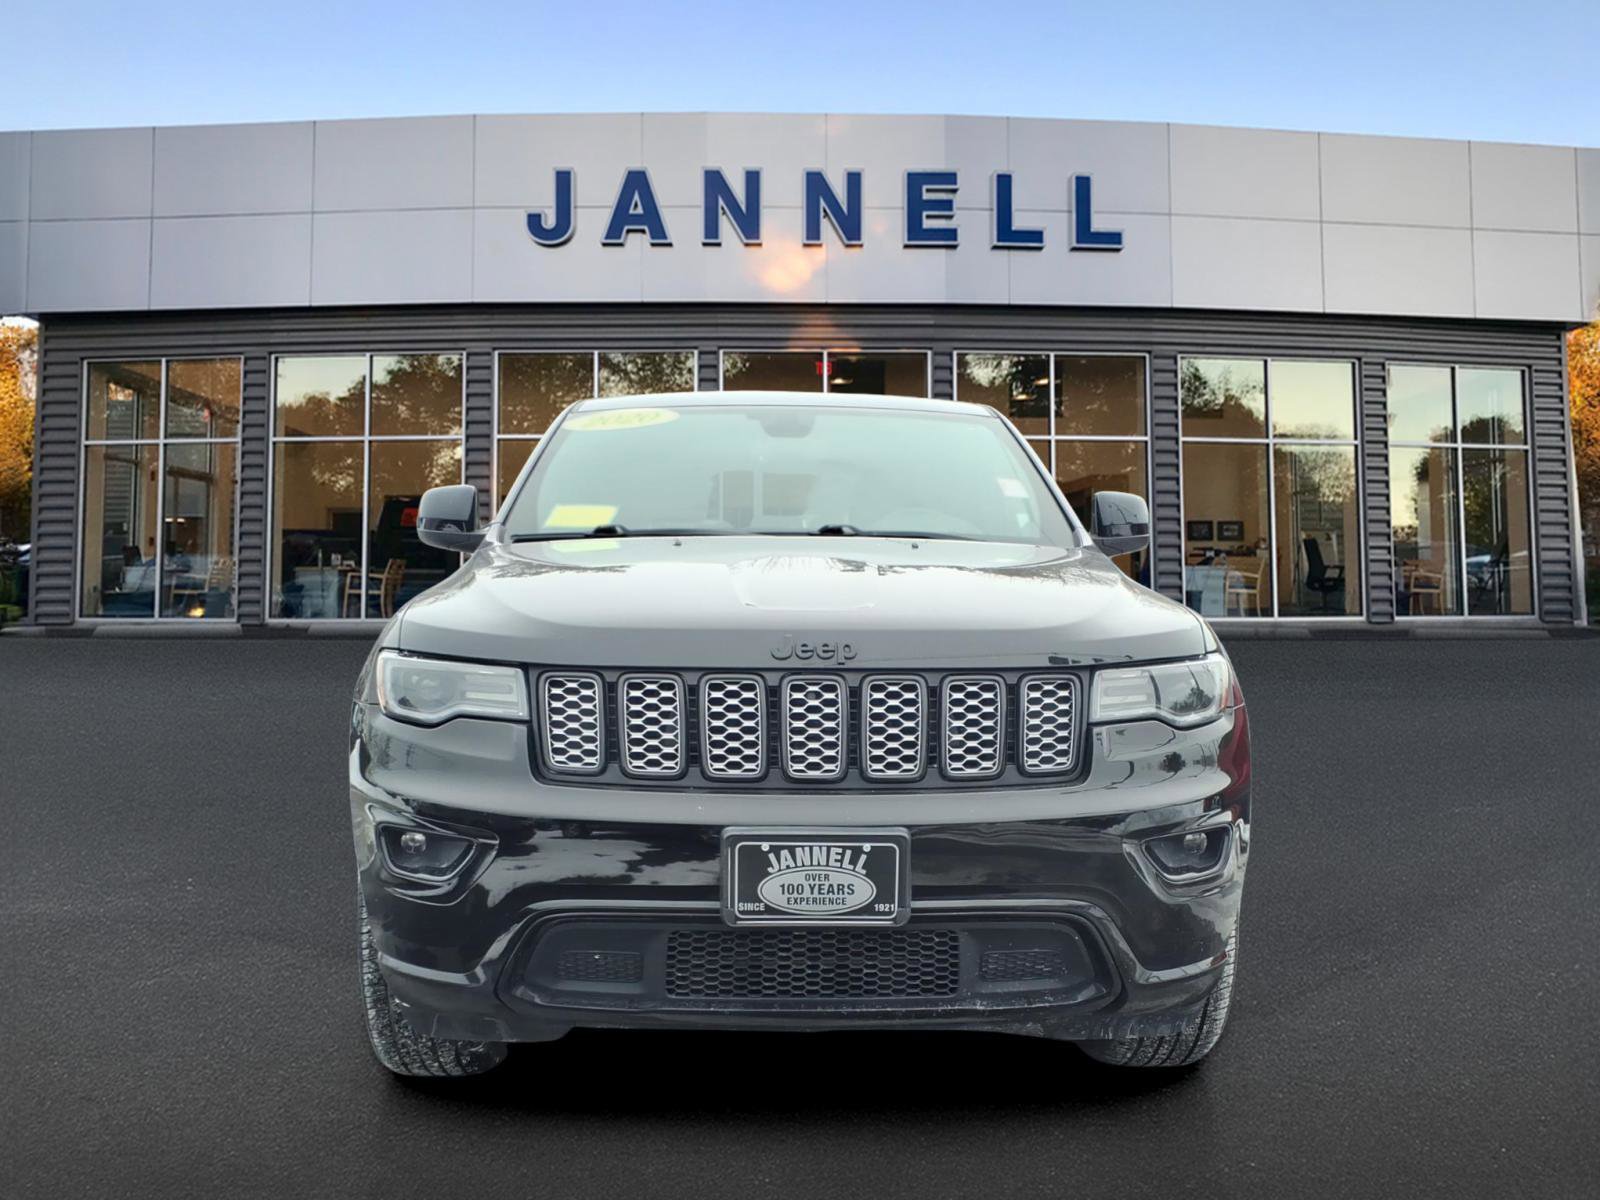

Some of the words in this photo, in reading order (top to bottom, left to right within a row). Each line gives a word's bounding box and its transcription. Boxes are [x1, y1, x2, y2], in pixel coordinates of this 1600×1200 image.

[526, 166, 1124, 251] JANNELL
[770, 633, 858, 666] Jeep
[766, 846, 869, 875] JANNELL
[804, 873, 830, 882] OVER
[779, 883, 805, 896] 100
[809, 883, 855, 896] YEARS
[738, 902, 765, 912] SINCE
[874, 903, 895, 912] 1921
[786, 896, 847, 906] EXPERIENCE
